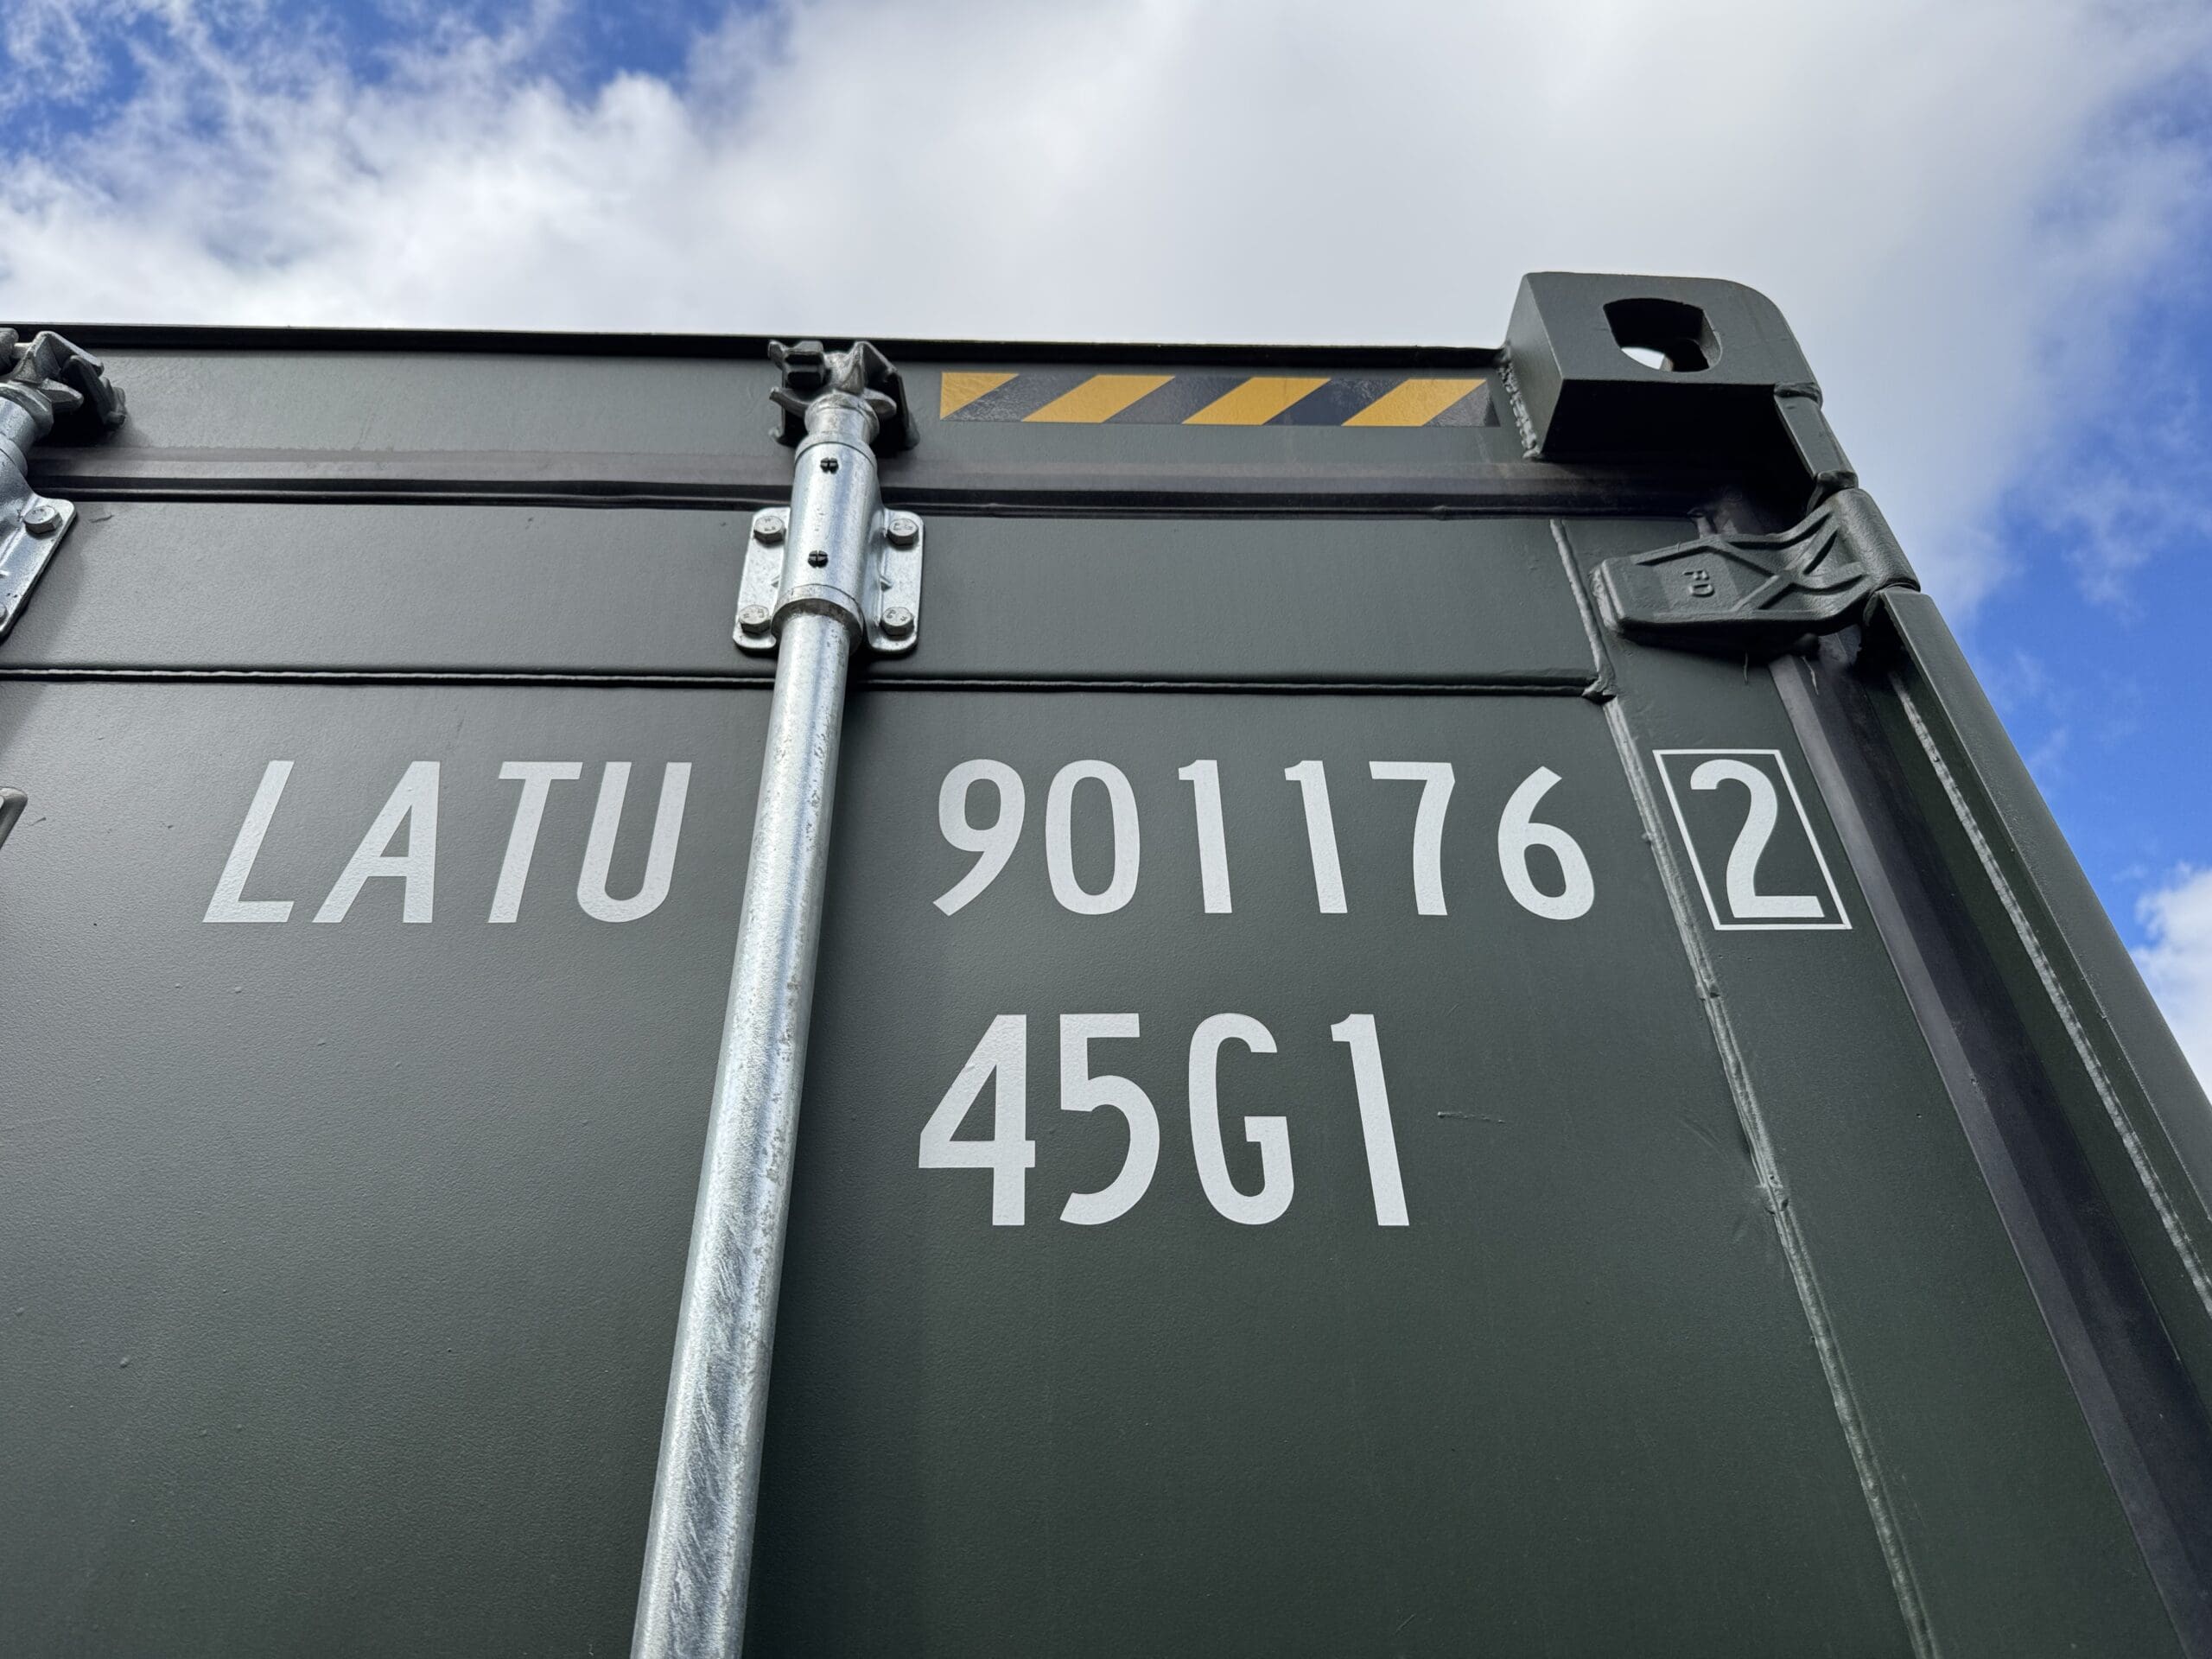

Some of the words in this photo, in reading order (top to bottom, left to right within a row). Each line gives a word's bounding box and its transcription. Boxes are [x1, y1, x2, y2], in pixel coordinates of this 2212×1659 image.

[202, 760, 693, 924] LATU
[932, 759, 1595, 920] 901176
[1689, 759, 1825, 918] 2
[918, 1013, 1410, 1226] 45G1
